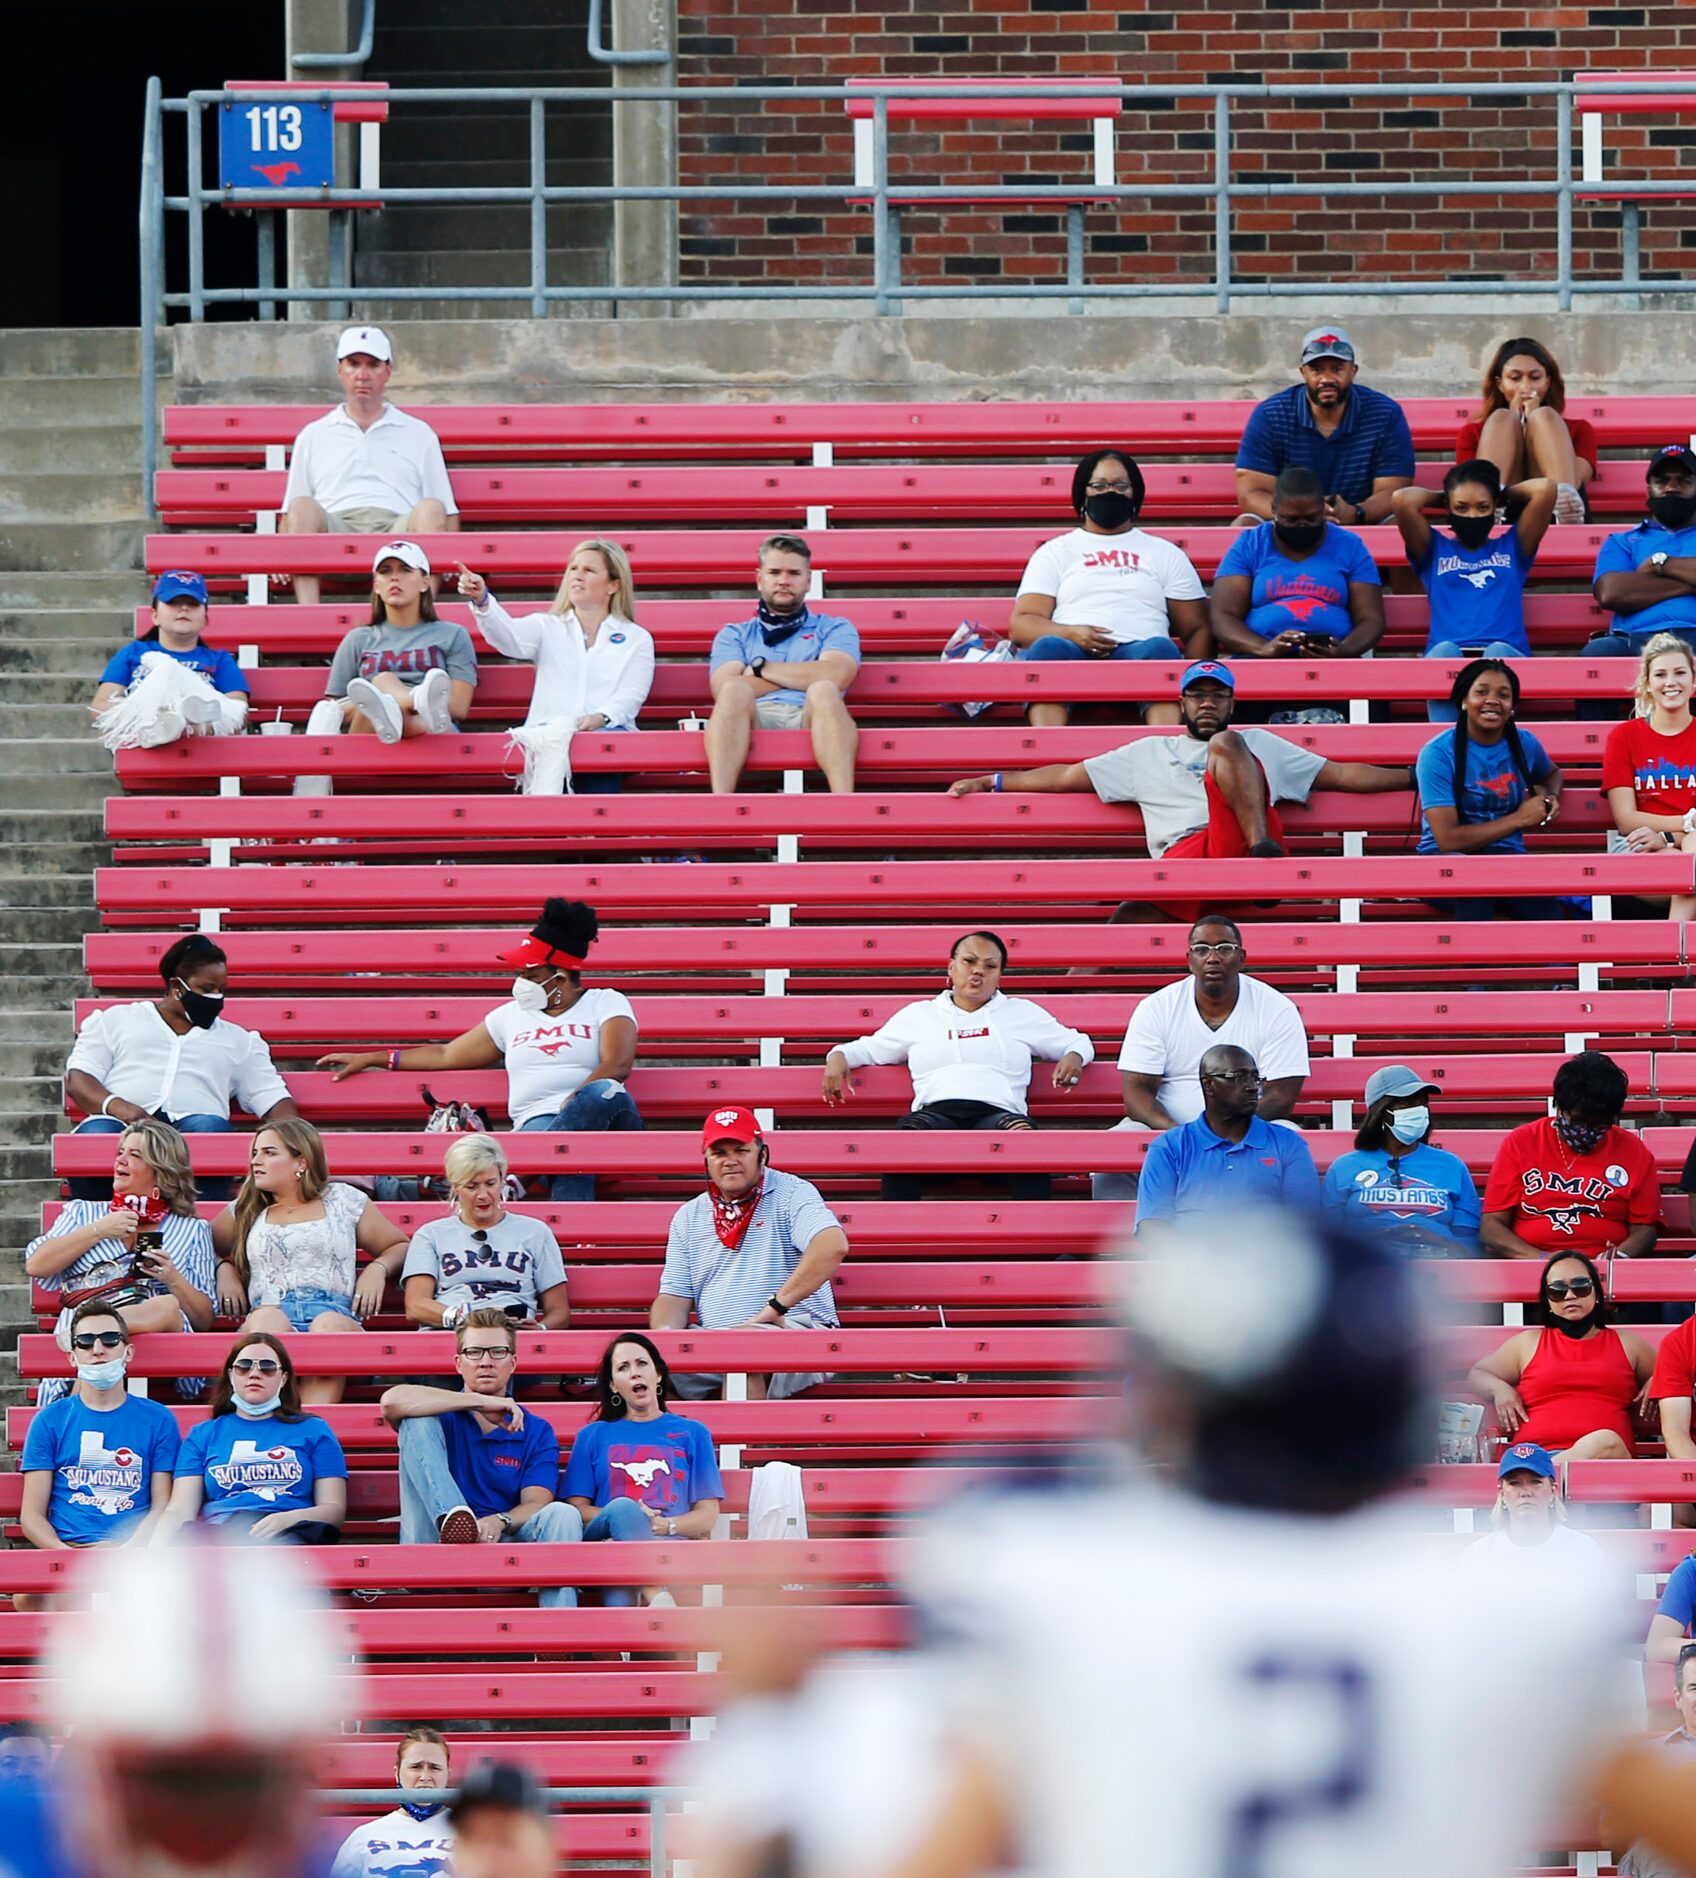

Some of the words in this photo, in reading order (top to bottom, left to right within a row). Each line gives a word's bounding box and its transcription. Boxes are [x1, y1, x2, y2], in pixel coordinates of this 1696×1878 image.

[246, 105, 303, 152] 113
[359, 645, 440, 678] SMU
[1440, 868, 1453, 878] 10
[1583, 867, 1595, 876] 11
[511, 1023, 593, 1049] SMU
[1432, 1068, 1445, 1078] 10
[1522, 1167, 1615, 1202] SMU
[1360, 1188, 1448, 1207] MUSTANGS
[441, 1249, 530, 1277] SMU
[240, 1463, 303, 1483] MUSTANGS
[1682, 1472, 1694, 1482] 11
